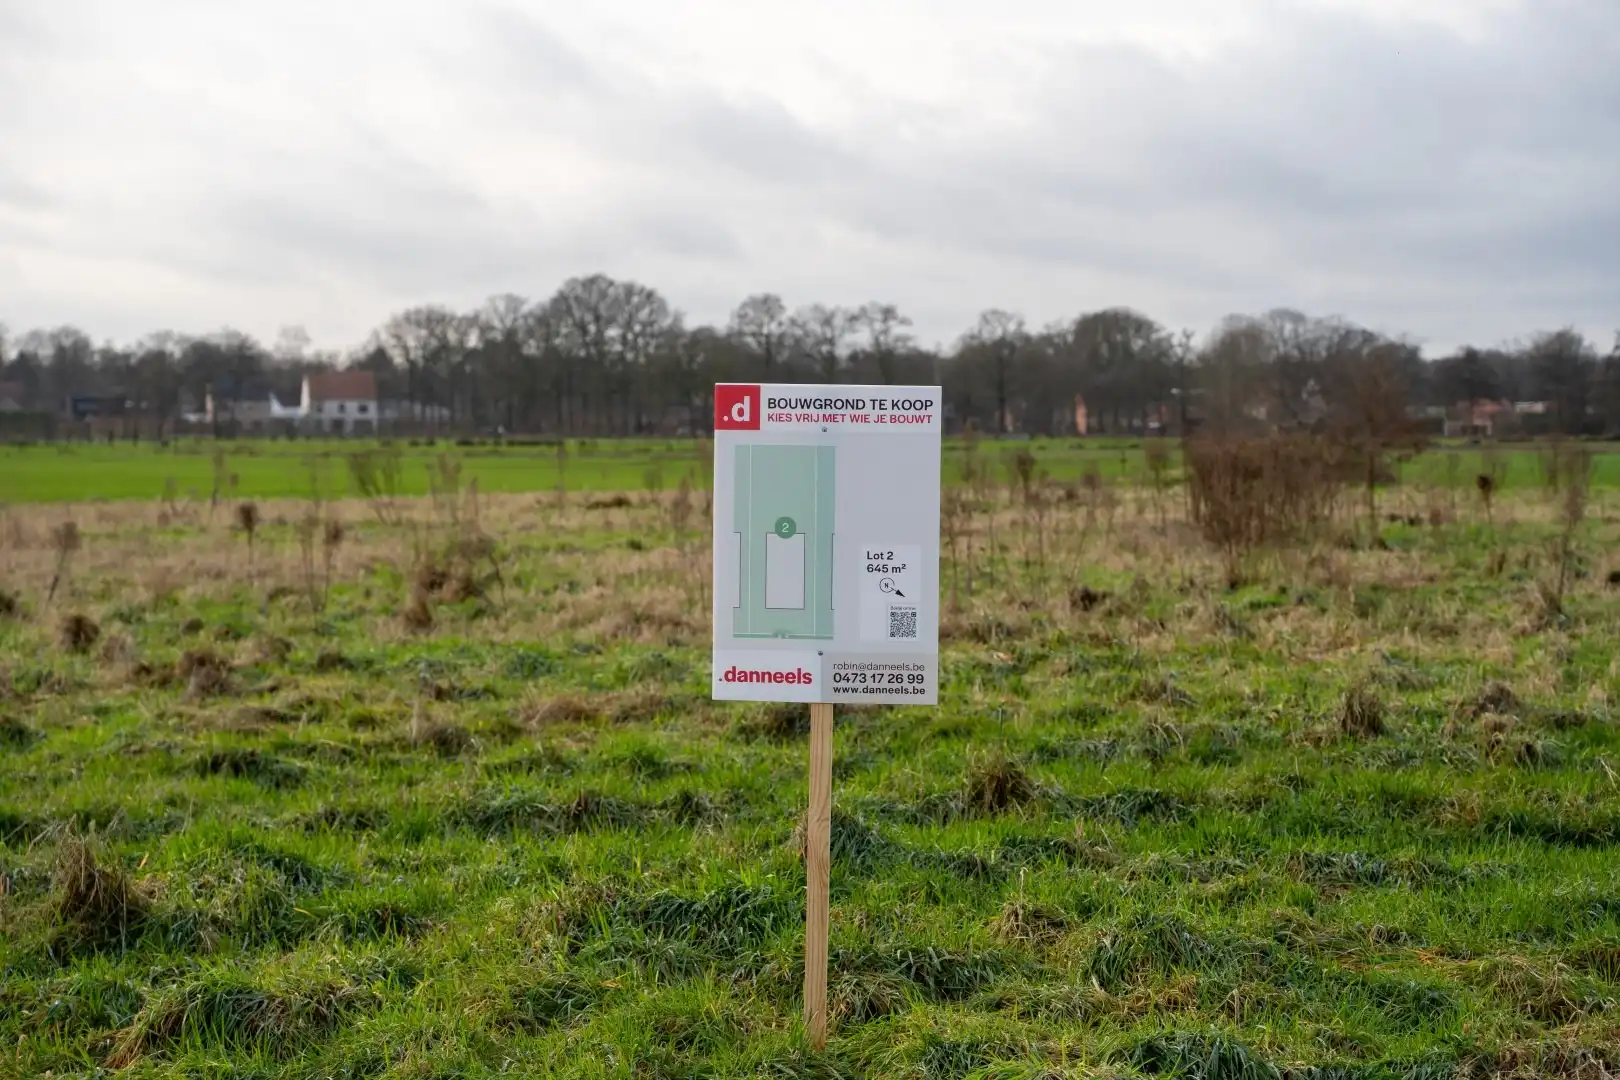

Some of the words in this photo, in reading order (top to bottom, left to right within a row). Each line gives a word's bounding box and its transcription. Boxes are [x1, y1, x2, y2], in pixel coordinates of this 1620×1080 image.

[768, 398, 866, 411] BOUWGROND
[870, 399, 888, 411] TE
[892, 400, 934, 411] KOOP
[767, 413, 793, 423] KIES
[795, 413, 820, 423] VRIJ
[822, 413, 847, 423] MET
[849, 414, 871, 424] WIE
[873, 414, 887, 424] JE
[890, 414, 933, 424] BOUWT
[781, 522, 789, 532] 2
[866, 550, 884, 560] Lot
[886, 551, 894, 561] 2
[866, 563, 889, 573] 645
[891, 563, 907, 573] m²
[833, 661, 925, 672] robin@danneels.be
[719, 665, 813, 684] .danneels
[833, 672, 867, 684] 0473
[870, 673, 885, 684] 17
[887, 673, 904, 684] 26
[906, 673, 925, 684] 99
[833, 685, 926, 695] www.danneels.be
